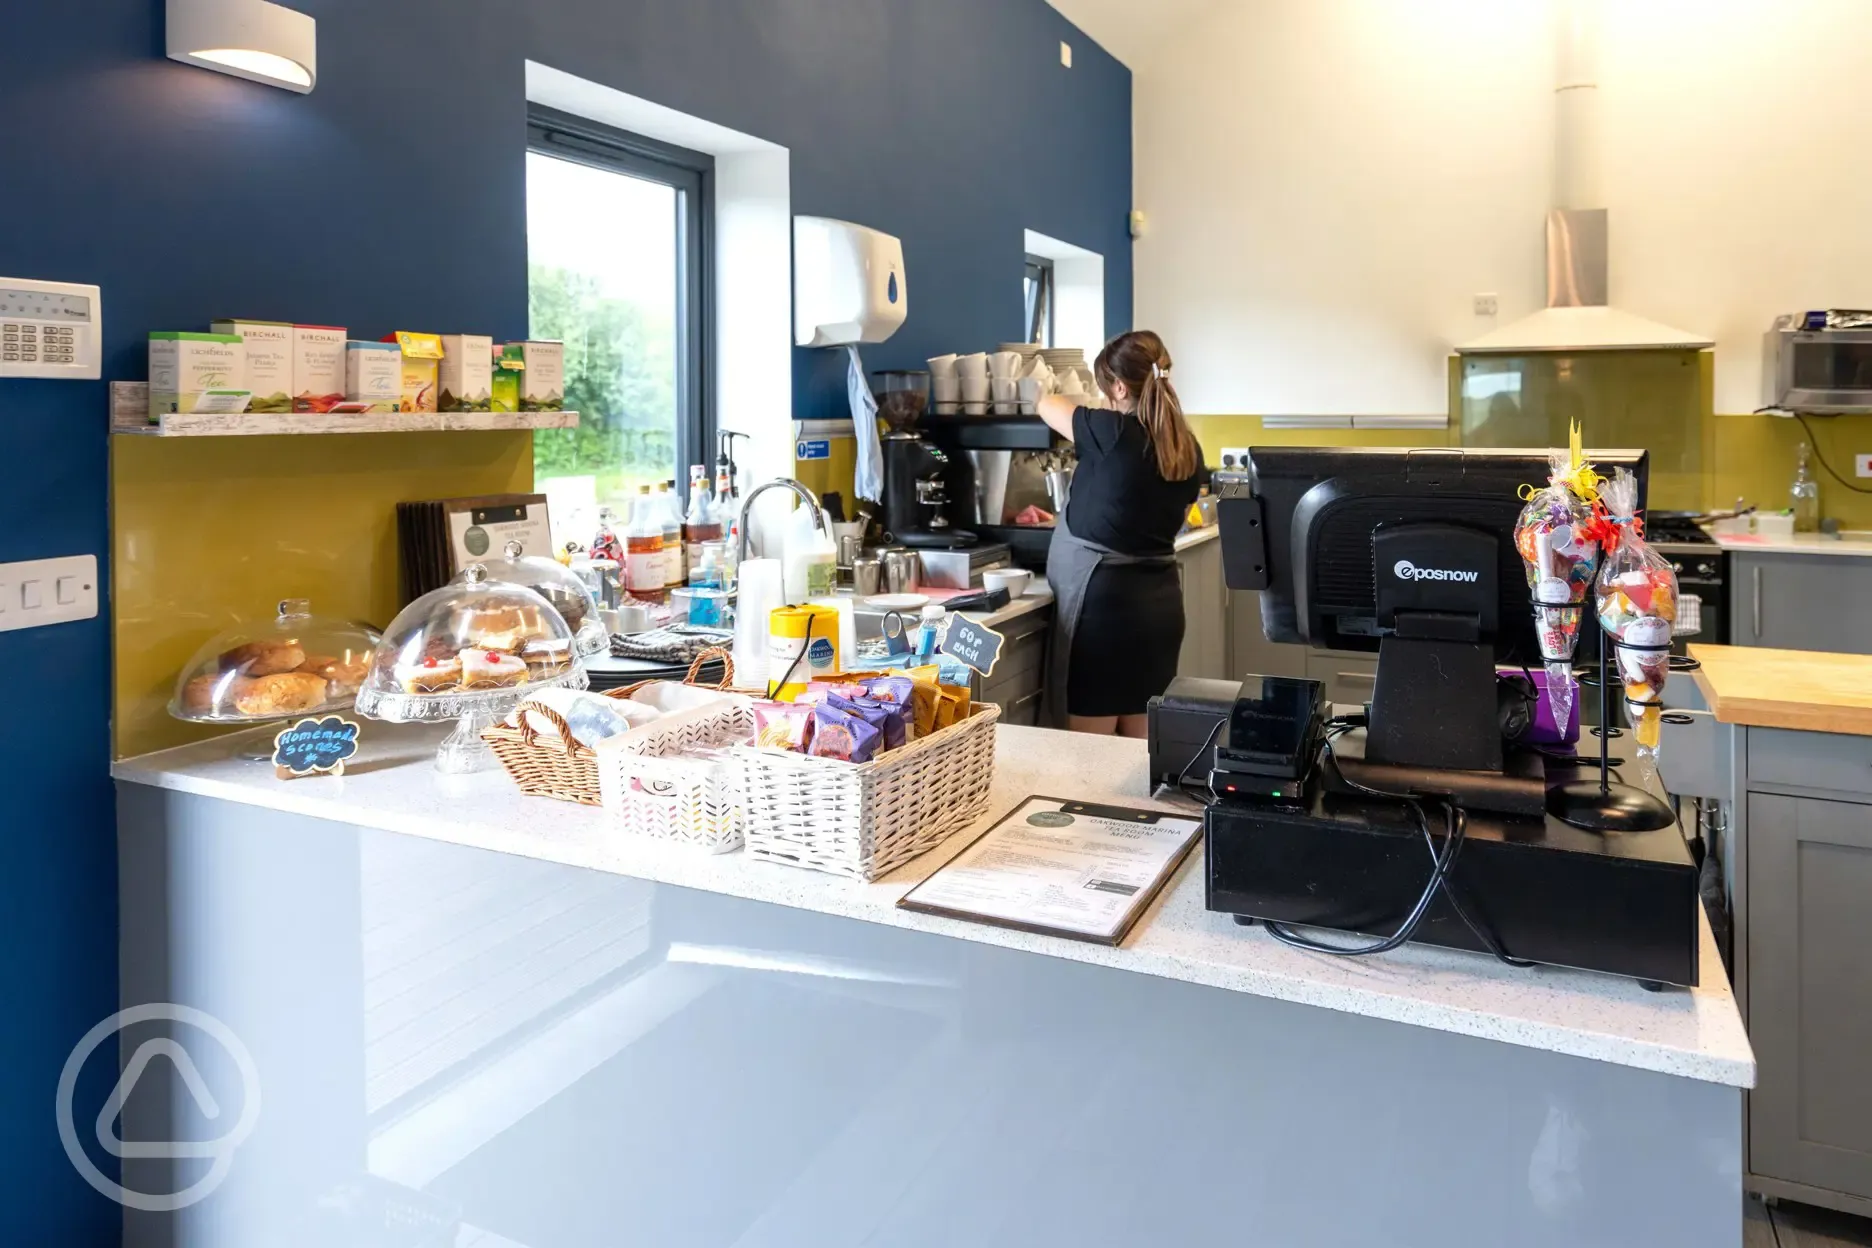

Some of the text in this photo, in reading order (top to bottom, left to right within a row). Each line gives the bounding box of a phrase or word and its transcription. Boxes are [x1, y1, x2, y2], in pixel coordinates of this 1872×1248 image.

[243, 330, 286, 339] BIRCHALL
[301, 334, 340, 343] BIRCHALL
[1394, 560, 1478, 582] eposnow
[952, 641, 979, 662] EACH
[1089, 818, 1181, 836] OAKWOOD MARINA
[1123, 827, 1155, 837] ROOM
[1110, 832, 1141, 840] MENU
